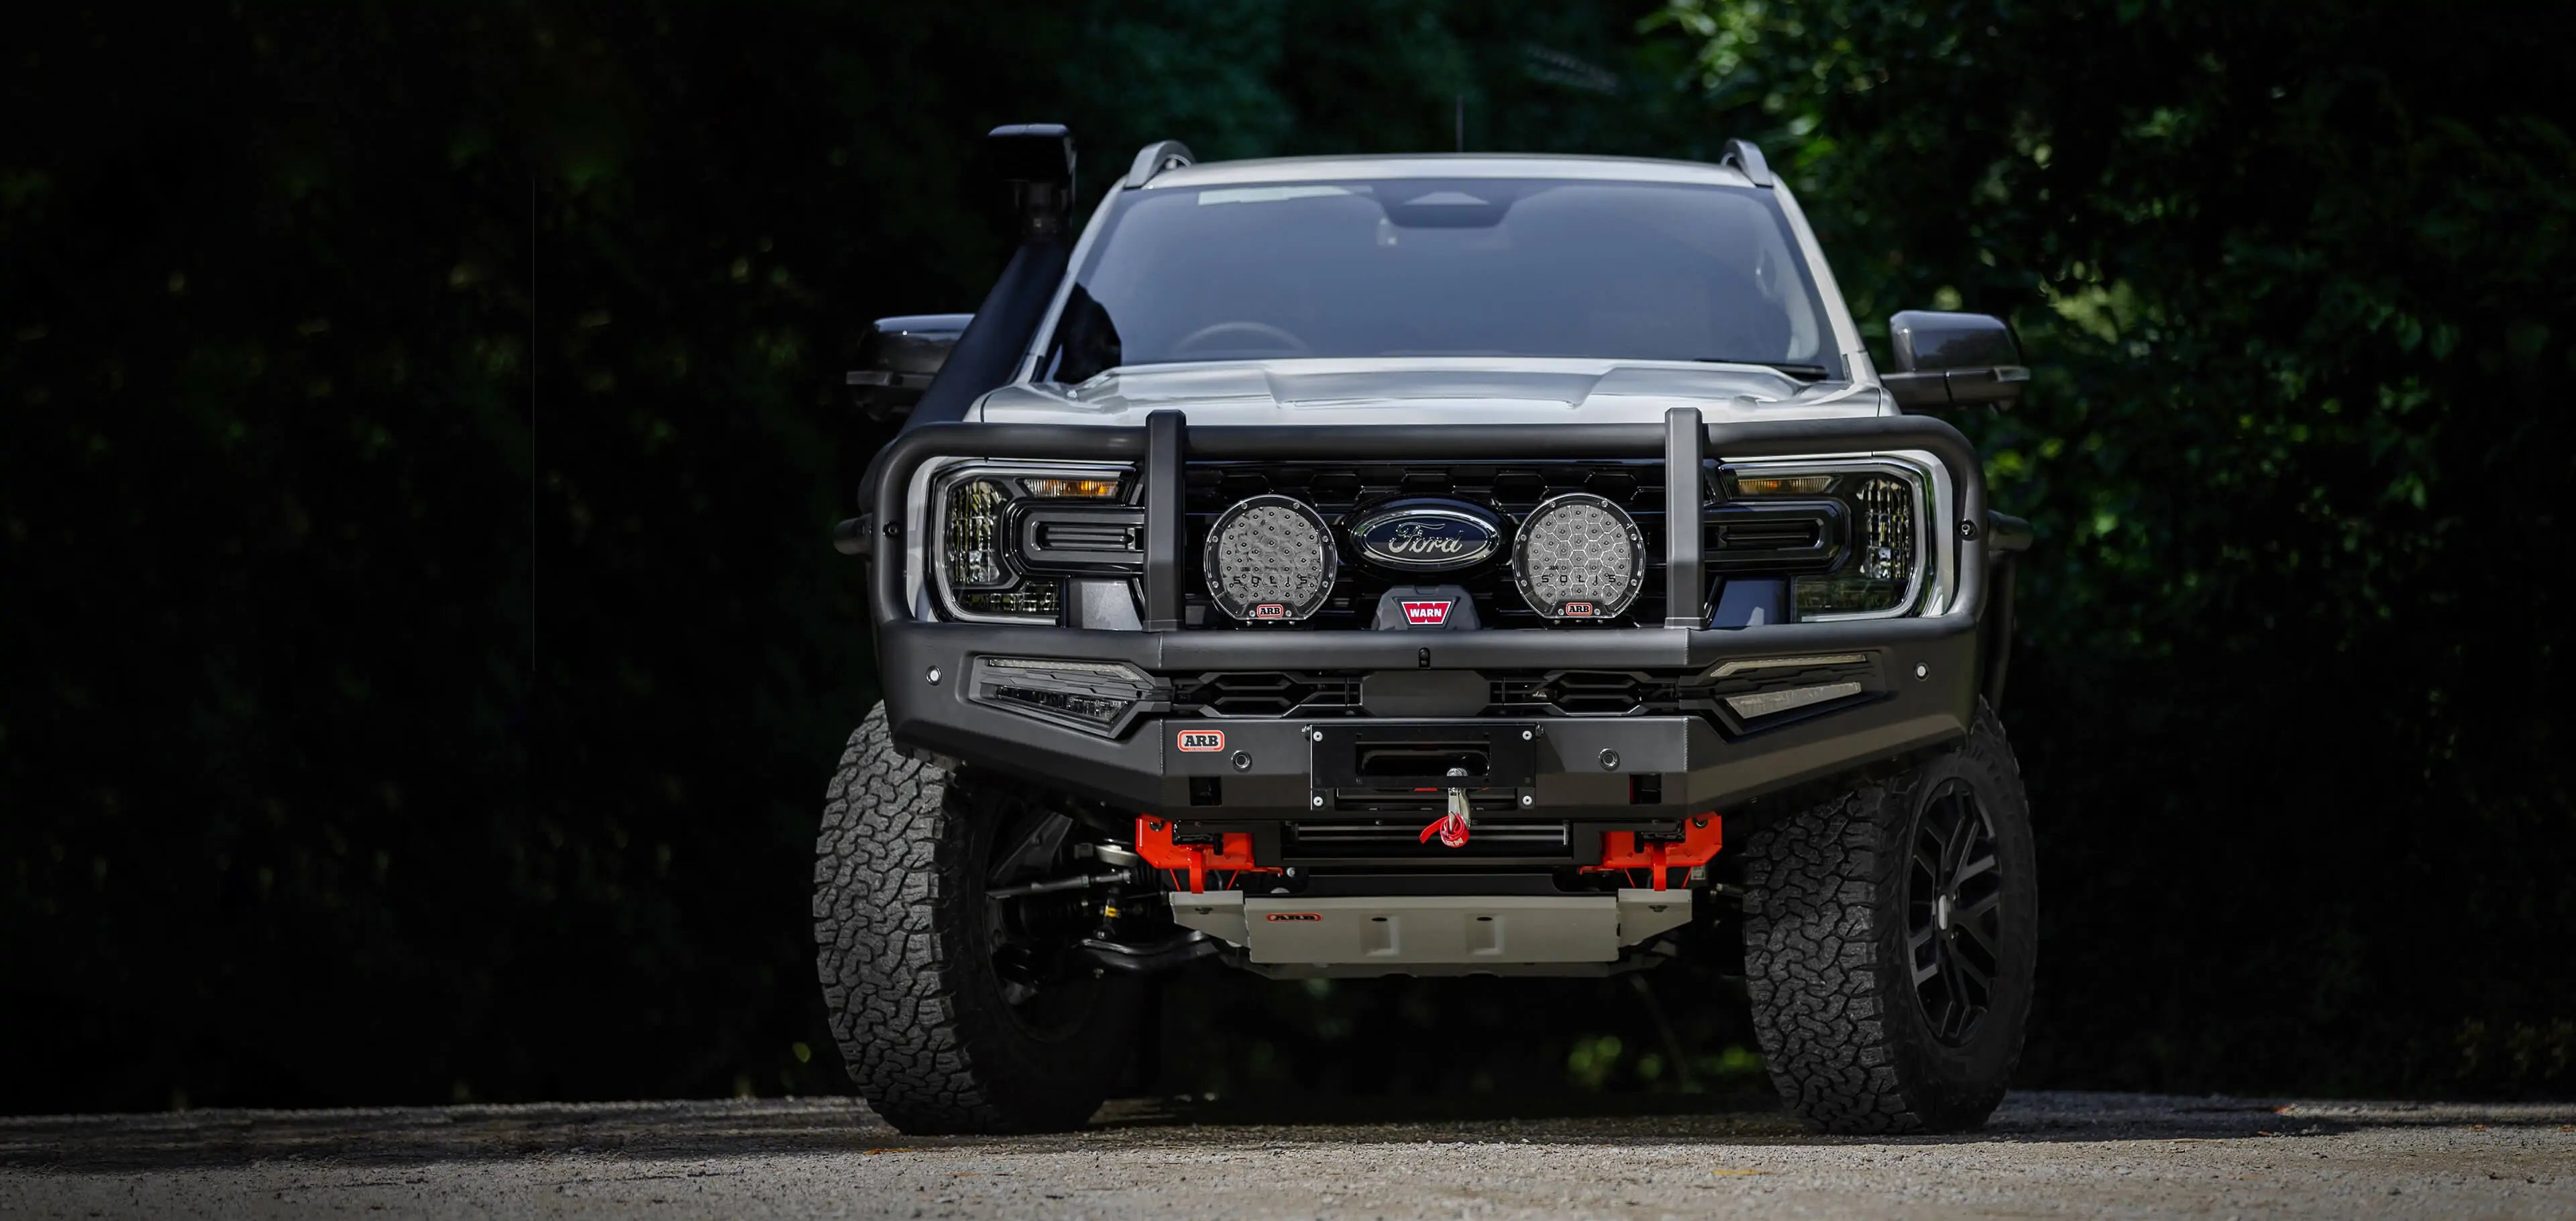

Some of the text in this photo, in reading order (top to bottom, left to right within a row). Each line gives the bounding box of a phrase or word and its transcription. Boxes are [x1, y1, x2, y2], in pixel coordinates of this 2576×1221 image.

[1389, 522, 1464, 553] Ford
[1542, 574, 1616, 583] SOLIS
[1410, 608, 1442, 617] WARN
[1185, 735, 1218, 747] ARB
